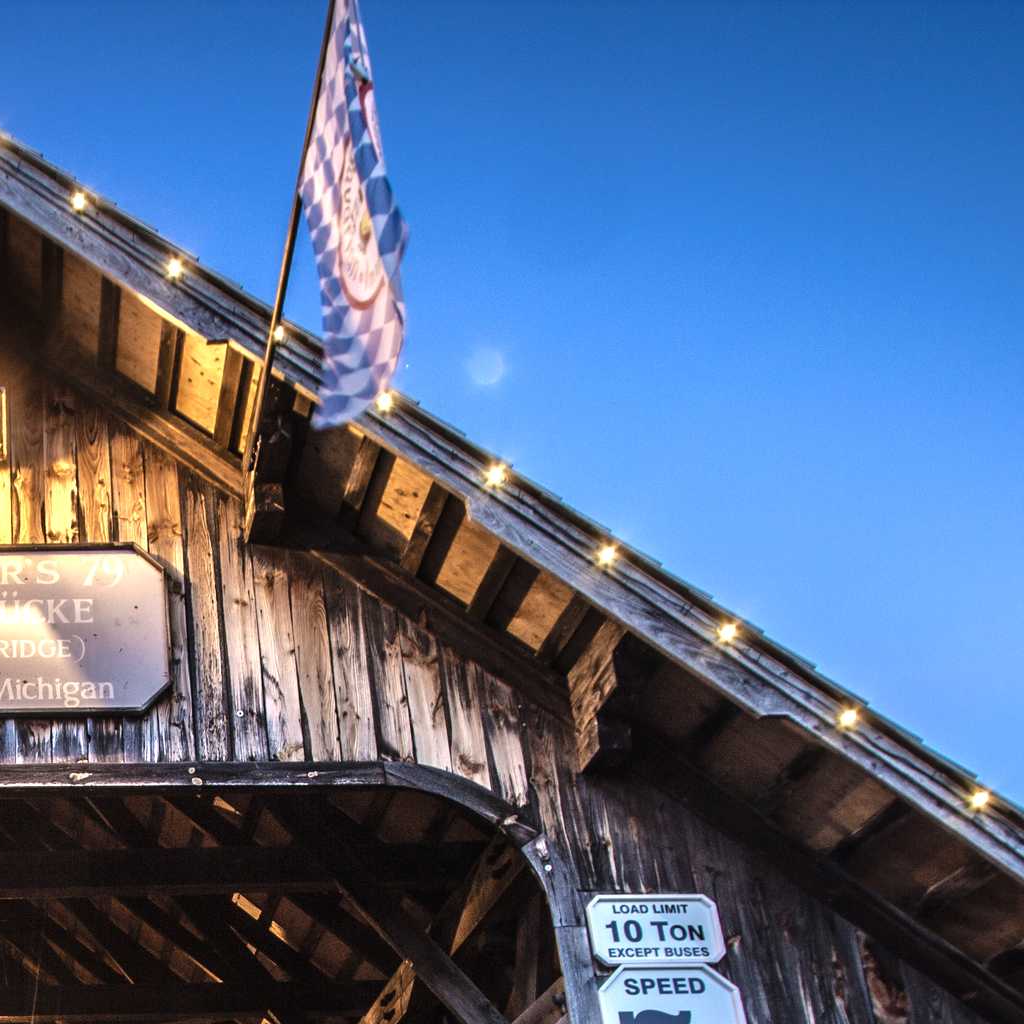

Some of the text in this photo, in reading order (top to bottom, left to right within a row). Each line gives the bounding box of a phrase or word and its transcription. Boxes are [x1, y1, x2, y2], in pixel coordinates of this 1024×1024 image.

[82, 559, 124, 587] 79
[612, 904, 688, 914] LOAD LIMIT
[606, 920, 643, 942] 10
[608, 947, 710, 958] EXCEPT BUSES
[624, 977, 706, 995] SPEED
